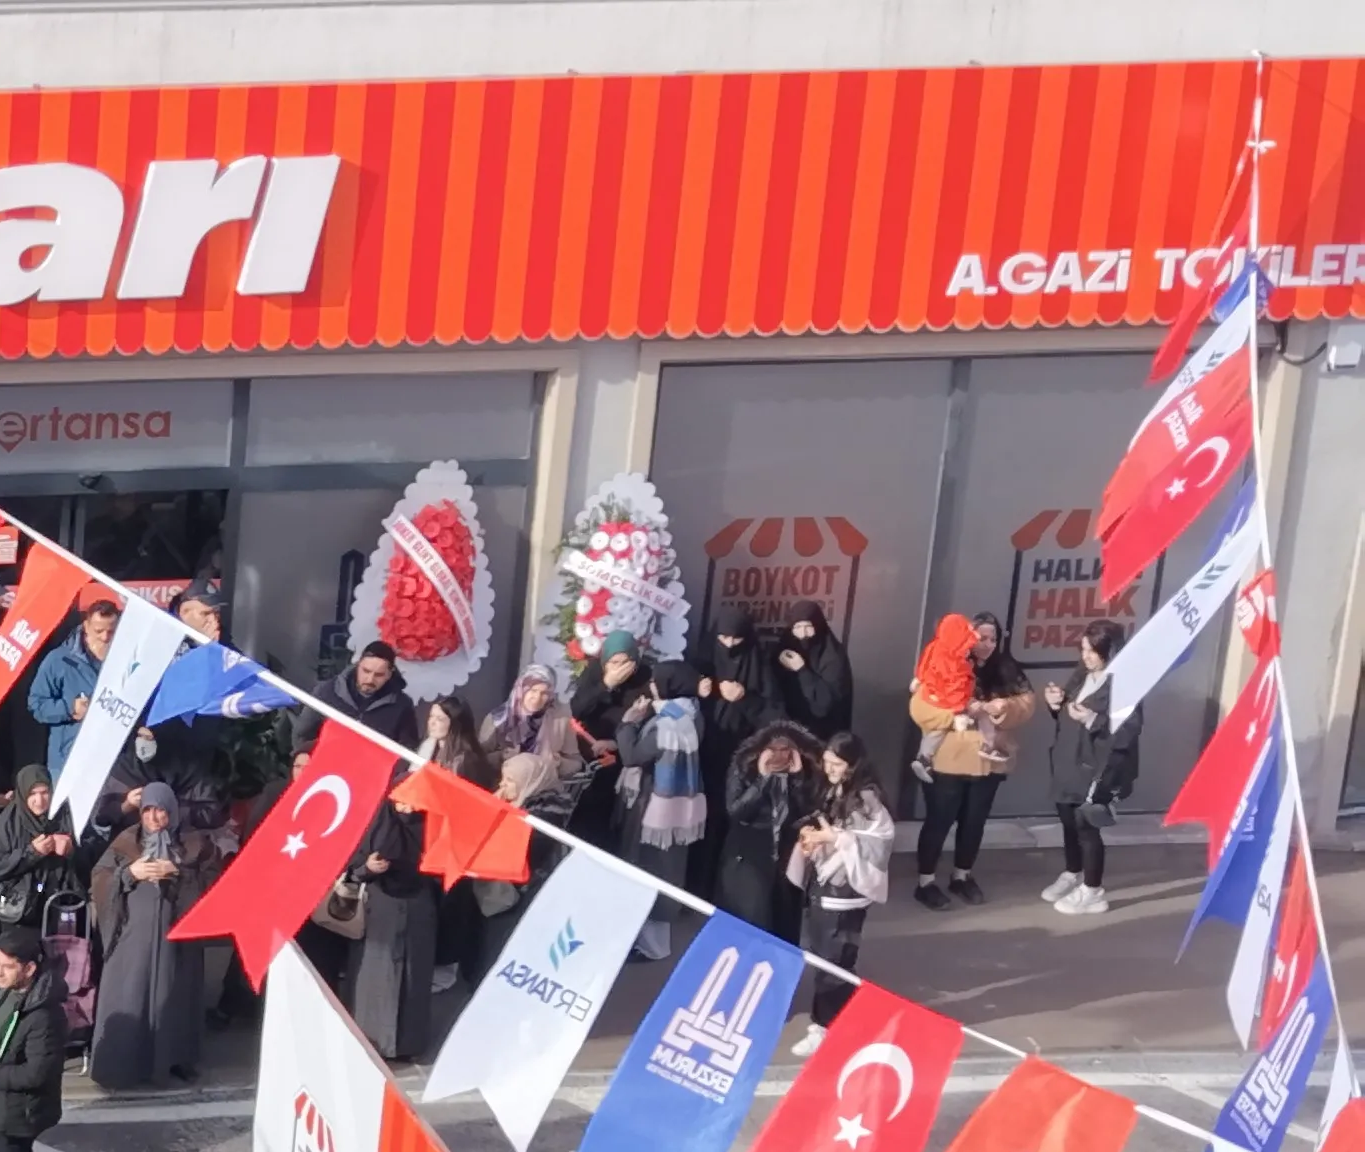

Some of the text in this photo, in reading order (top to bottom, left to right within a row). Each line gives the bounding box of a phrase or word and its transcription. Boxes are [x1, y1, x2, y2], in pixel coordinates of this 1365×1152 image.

[721, 566, 840, 597] BOYKOT
[1027, 586, 1140, 619] HALK
[1024, 622, 1136, 649] PAZI
